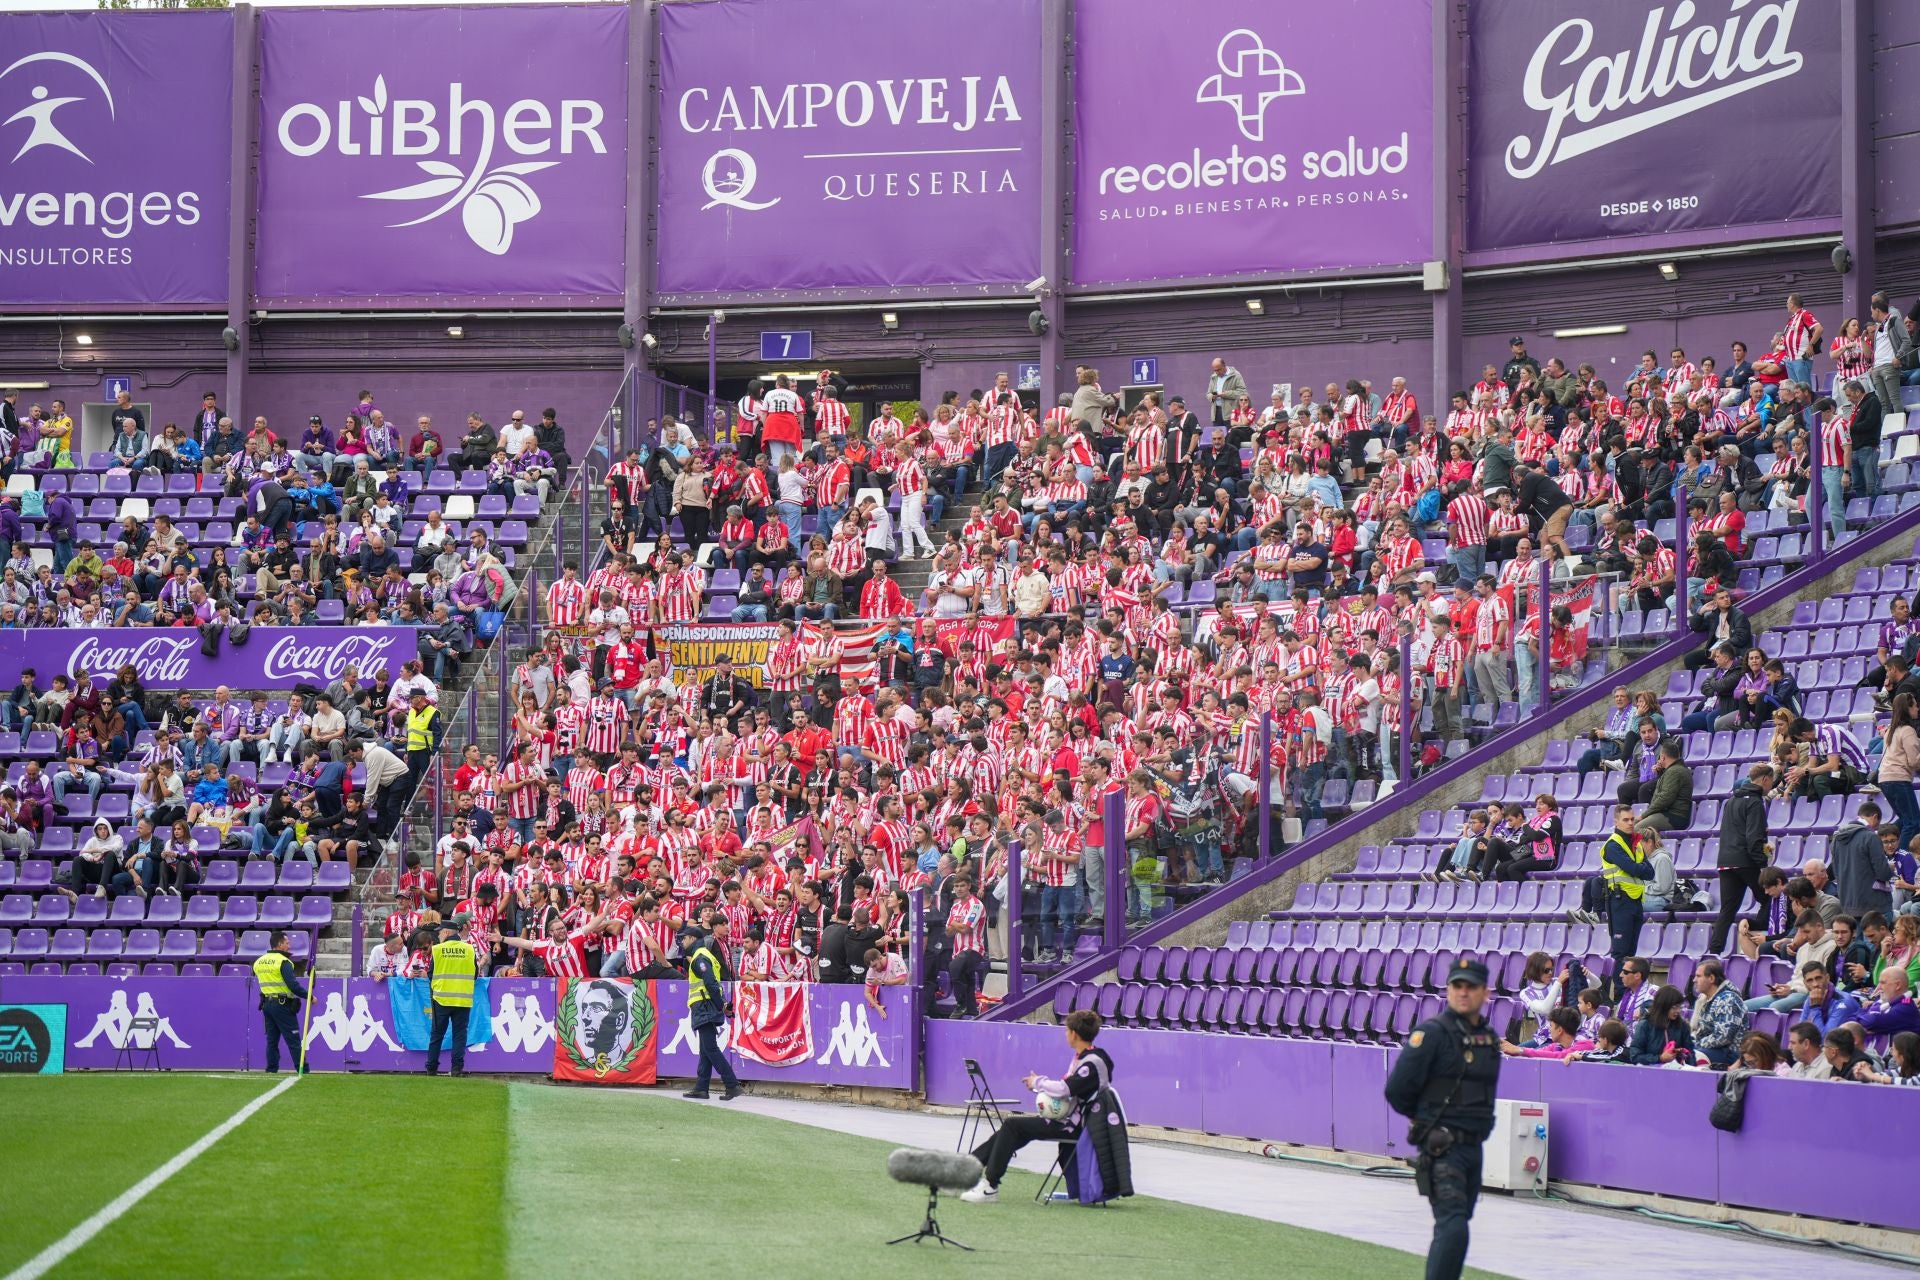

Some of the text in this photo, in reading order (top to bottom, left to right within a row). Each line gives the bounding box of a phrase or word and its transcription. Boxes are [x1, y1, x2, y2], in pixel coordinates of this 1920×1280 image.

[680, 76, 1022, 132] CAMPOVEJA
[1505, 0, 1803, 178] Galicia
[1100, 132, 1408, 195] recoletas salud
[824, 169, 1018, 201] QUESERIA
[0, 192, 200, 239] venges
[1600, 195, 1699, 217] DESDE 1850
[780, 335, 792, 357] 7
[660, 625, 690, 640] PEÑA
[67, 636, 198, 681] Coca-Cola
[264, 635, 396, 681] Coca-Cola
[671, 641, 769, 666] SENTIMIENTO
[441, 947, 466, 955] EULEN
